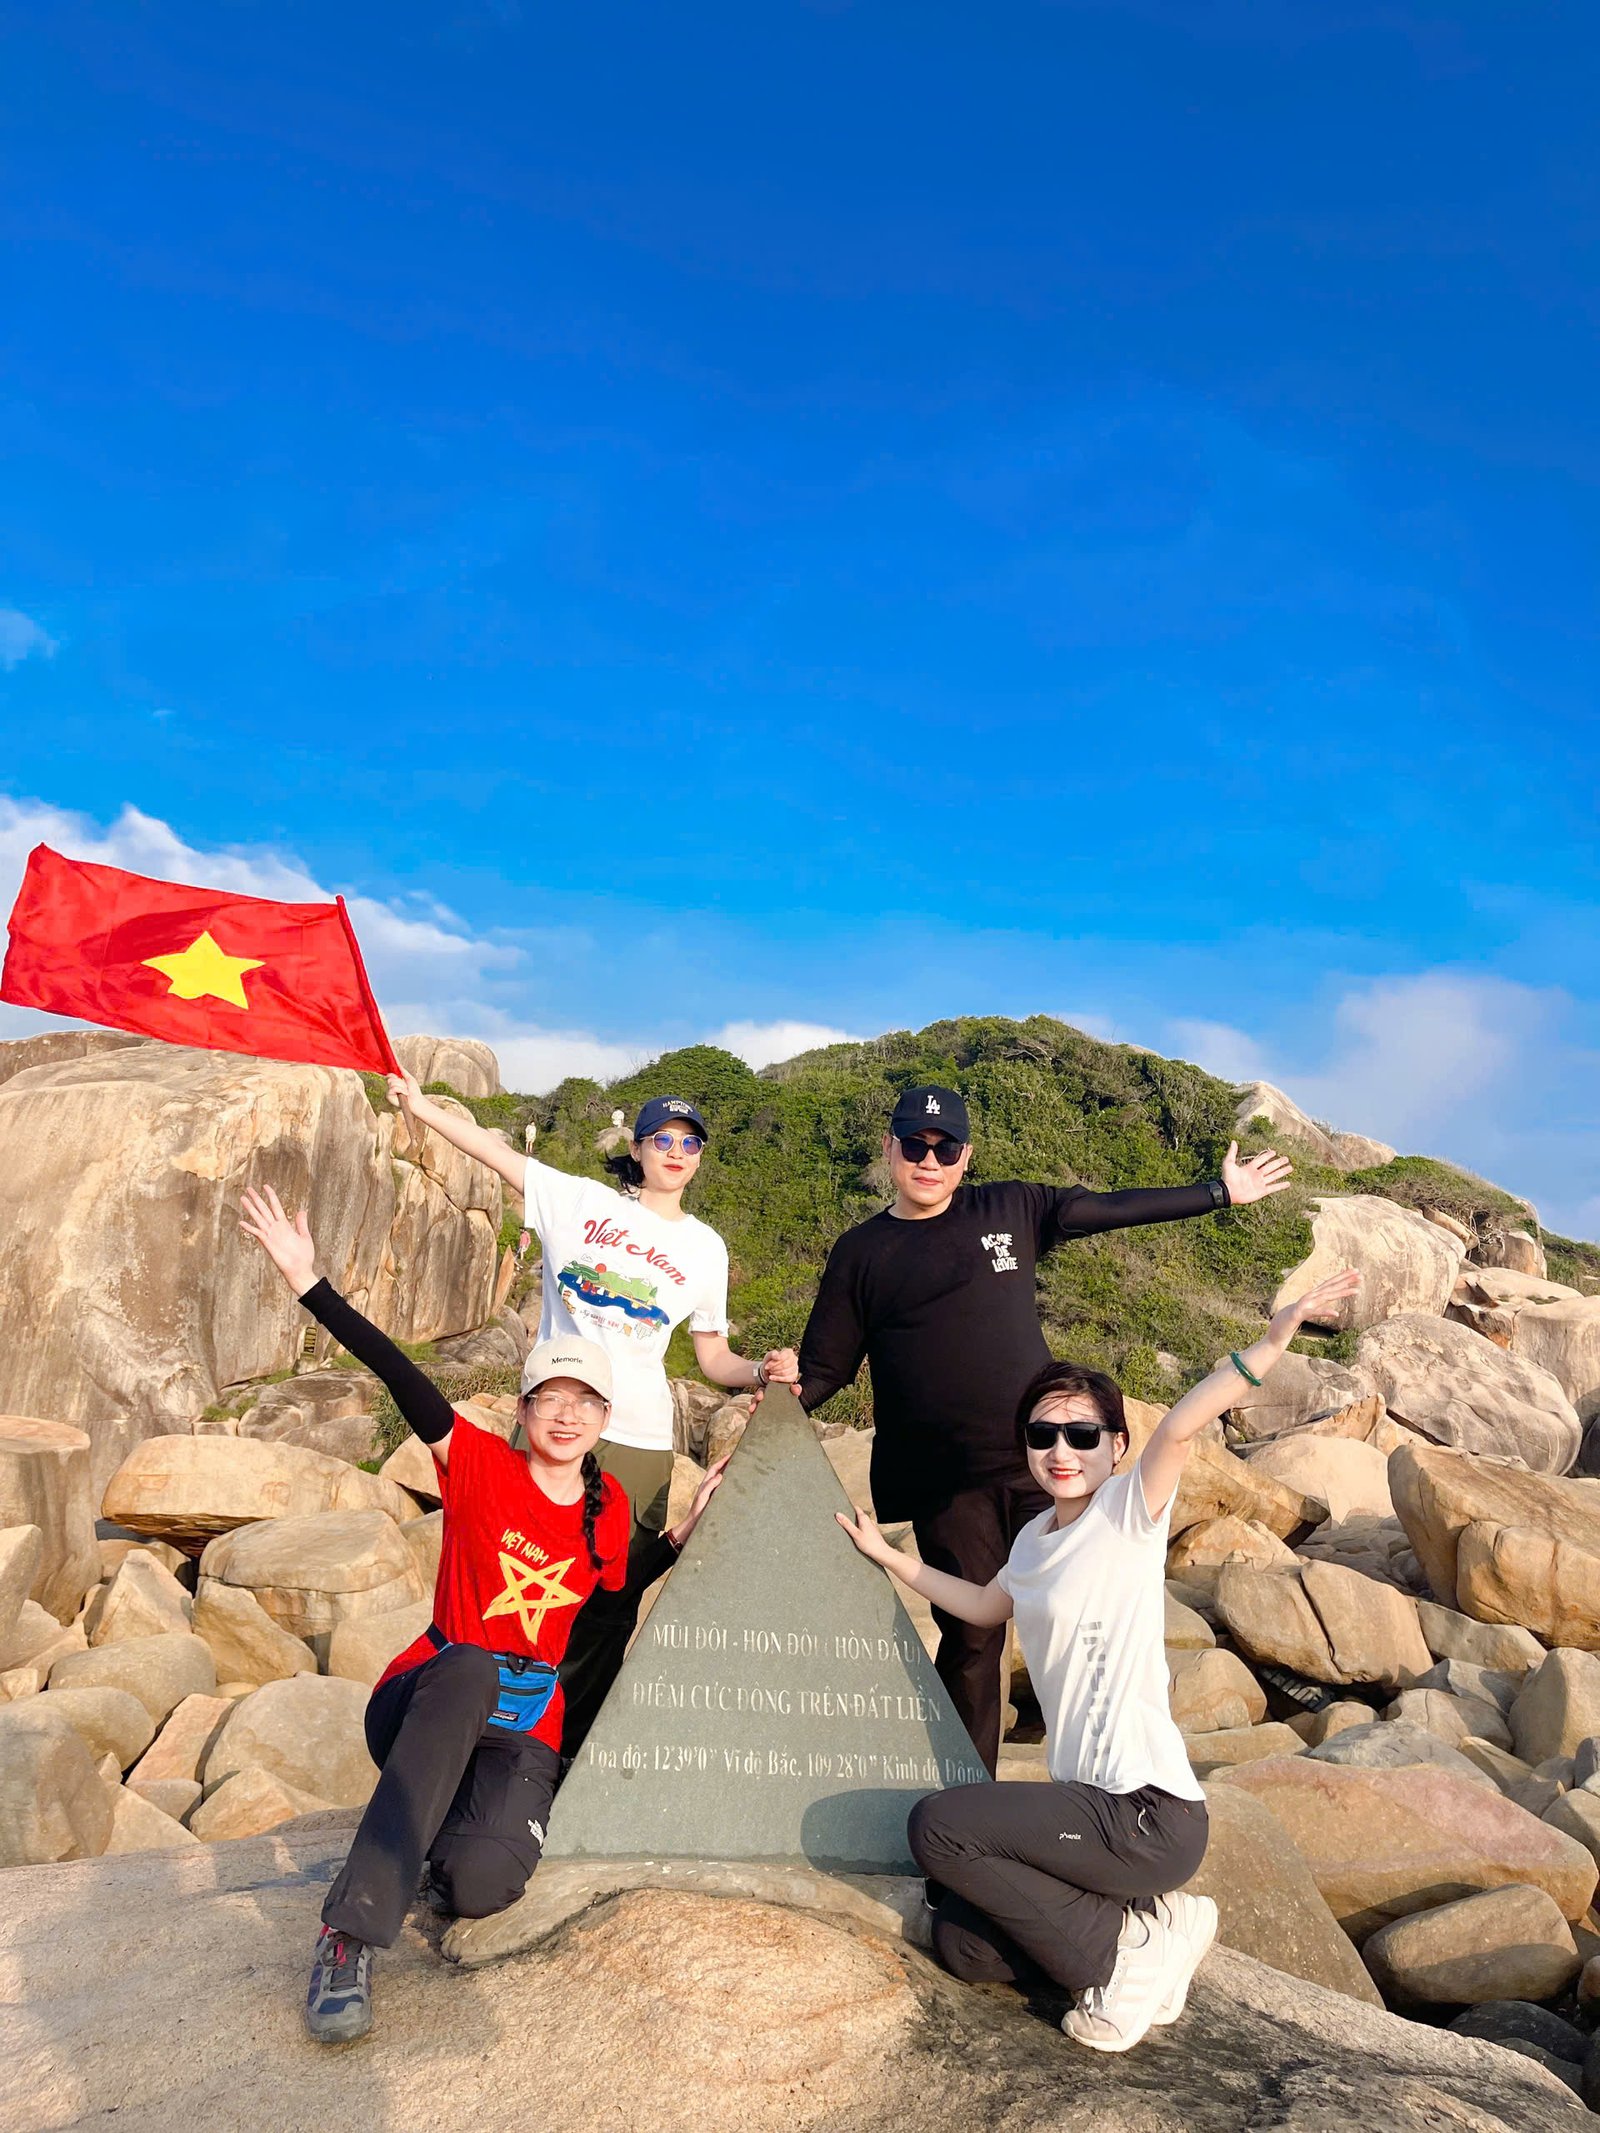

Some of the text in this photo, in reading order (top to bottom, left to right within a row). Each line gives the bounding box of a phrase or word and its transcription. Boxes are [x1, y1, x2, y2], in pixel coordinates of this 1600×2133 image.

[925, 1094, 941, 1115] LA
[583, 1218, 688, 1286] Việt Nam
[994, 1245, 1010, 1257] DE
[520, 1541, 550, 1566] NAM
[798, 1685, 849, 1717] TRÊN
[853, 1683, 892, 1719] ĐẤT
[587, 1742, 617, 1774] Tọa
[883, 1755, 919, 1781] Kinh
